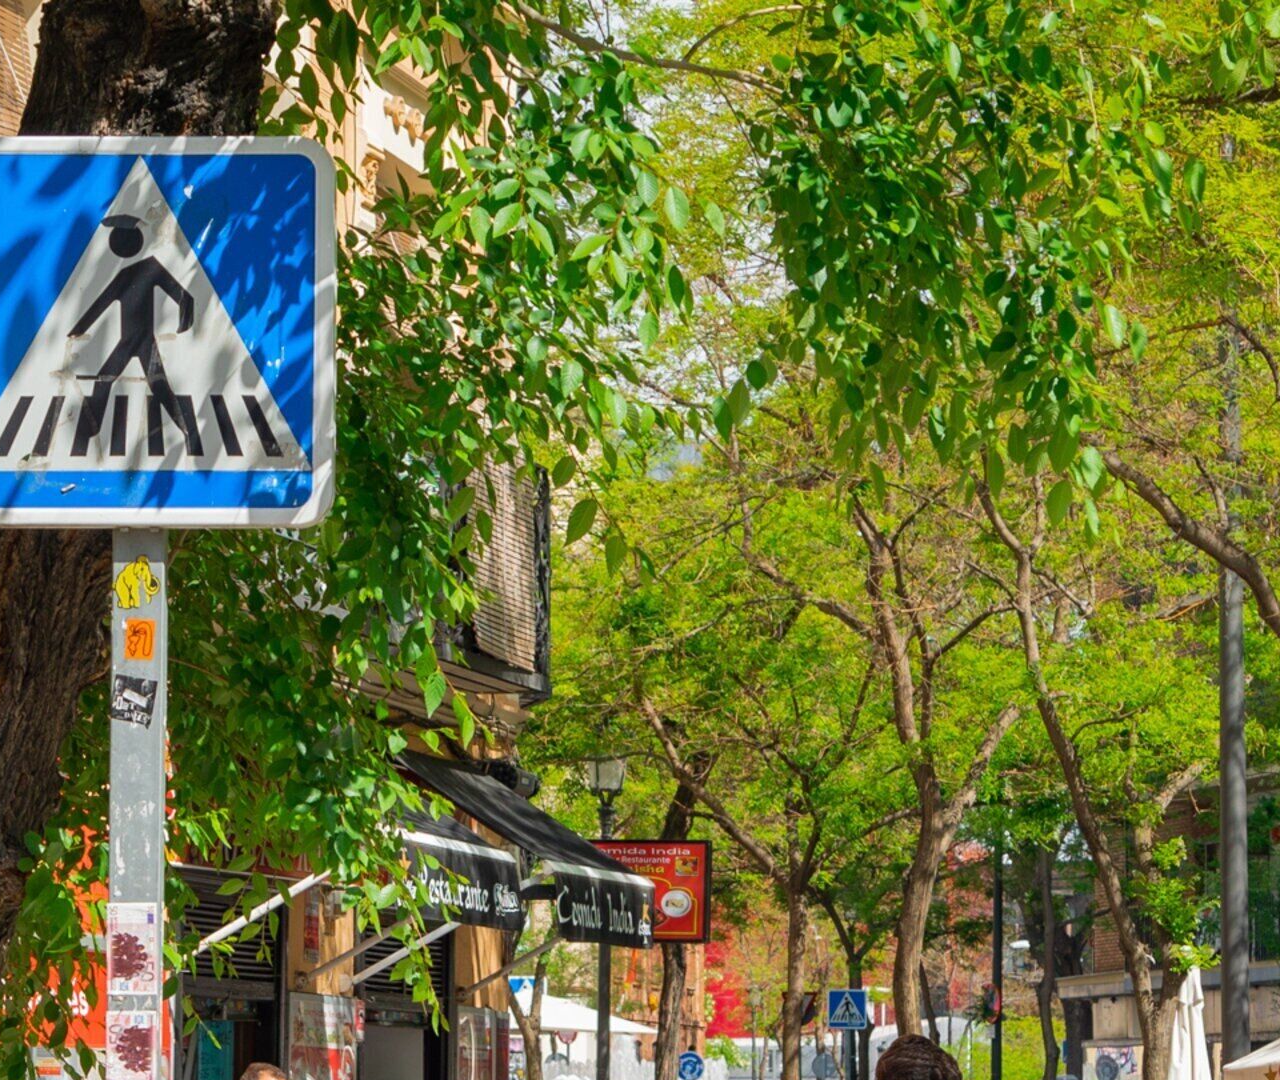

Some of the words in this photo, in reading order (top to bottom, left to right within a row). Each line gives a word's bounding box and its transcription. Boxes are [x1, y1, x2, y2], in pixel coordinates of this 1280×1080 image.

[652, 847, 691, 855] India
[621, 855, 672, 864] Restaurante
[556, 885, 602, 929] Comida
[607, 892, 635, 935] India
